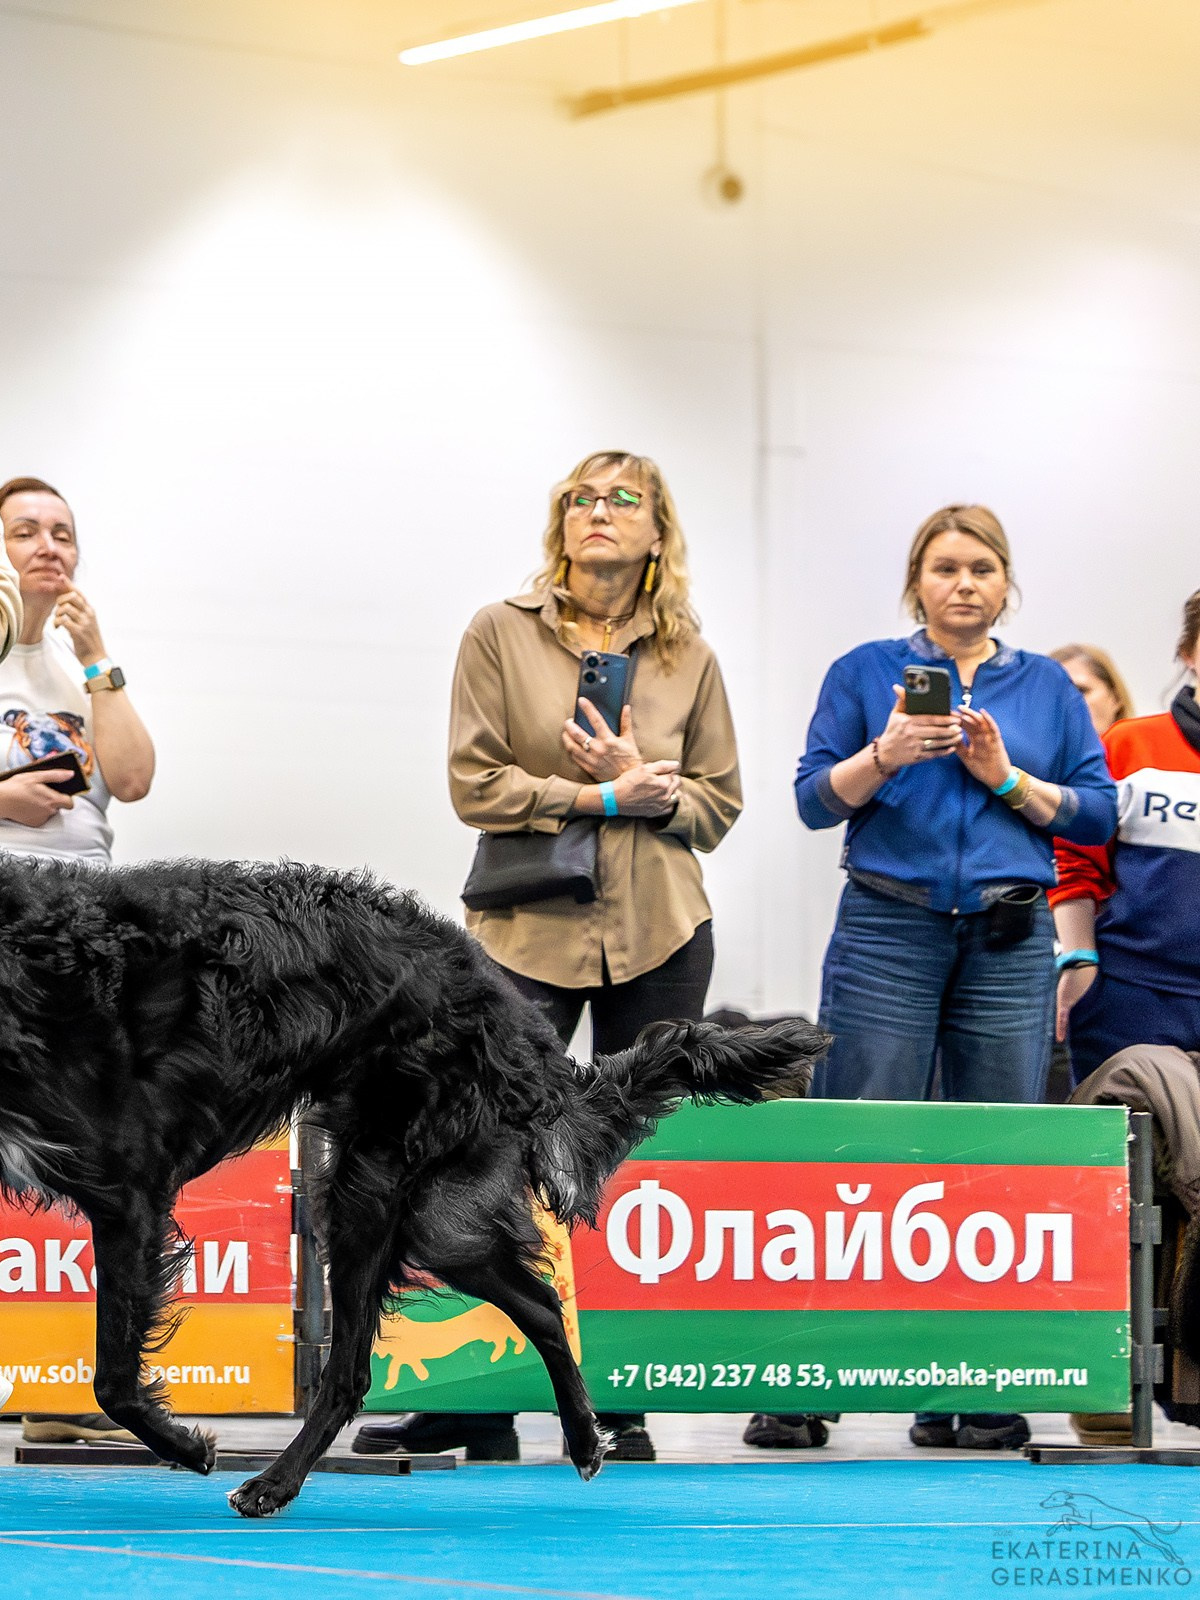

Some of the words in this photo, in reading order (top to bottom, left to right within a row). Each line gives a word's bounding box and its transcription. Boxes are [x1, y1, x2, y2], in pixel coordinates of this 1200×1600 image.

[606, 1179, 1073, 1284] Флайбол
[607, 1364, 639, 1388] +7
[645, 1362, 706, 1391] (342)
[711, 1363, 757, 1387] 237
[761, 1363, 792, 1387] 48
[796, 1363, 833, 1390] 53,
[837, 1361, 1089, 1393] www.sobaka-perm.ru
